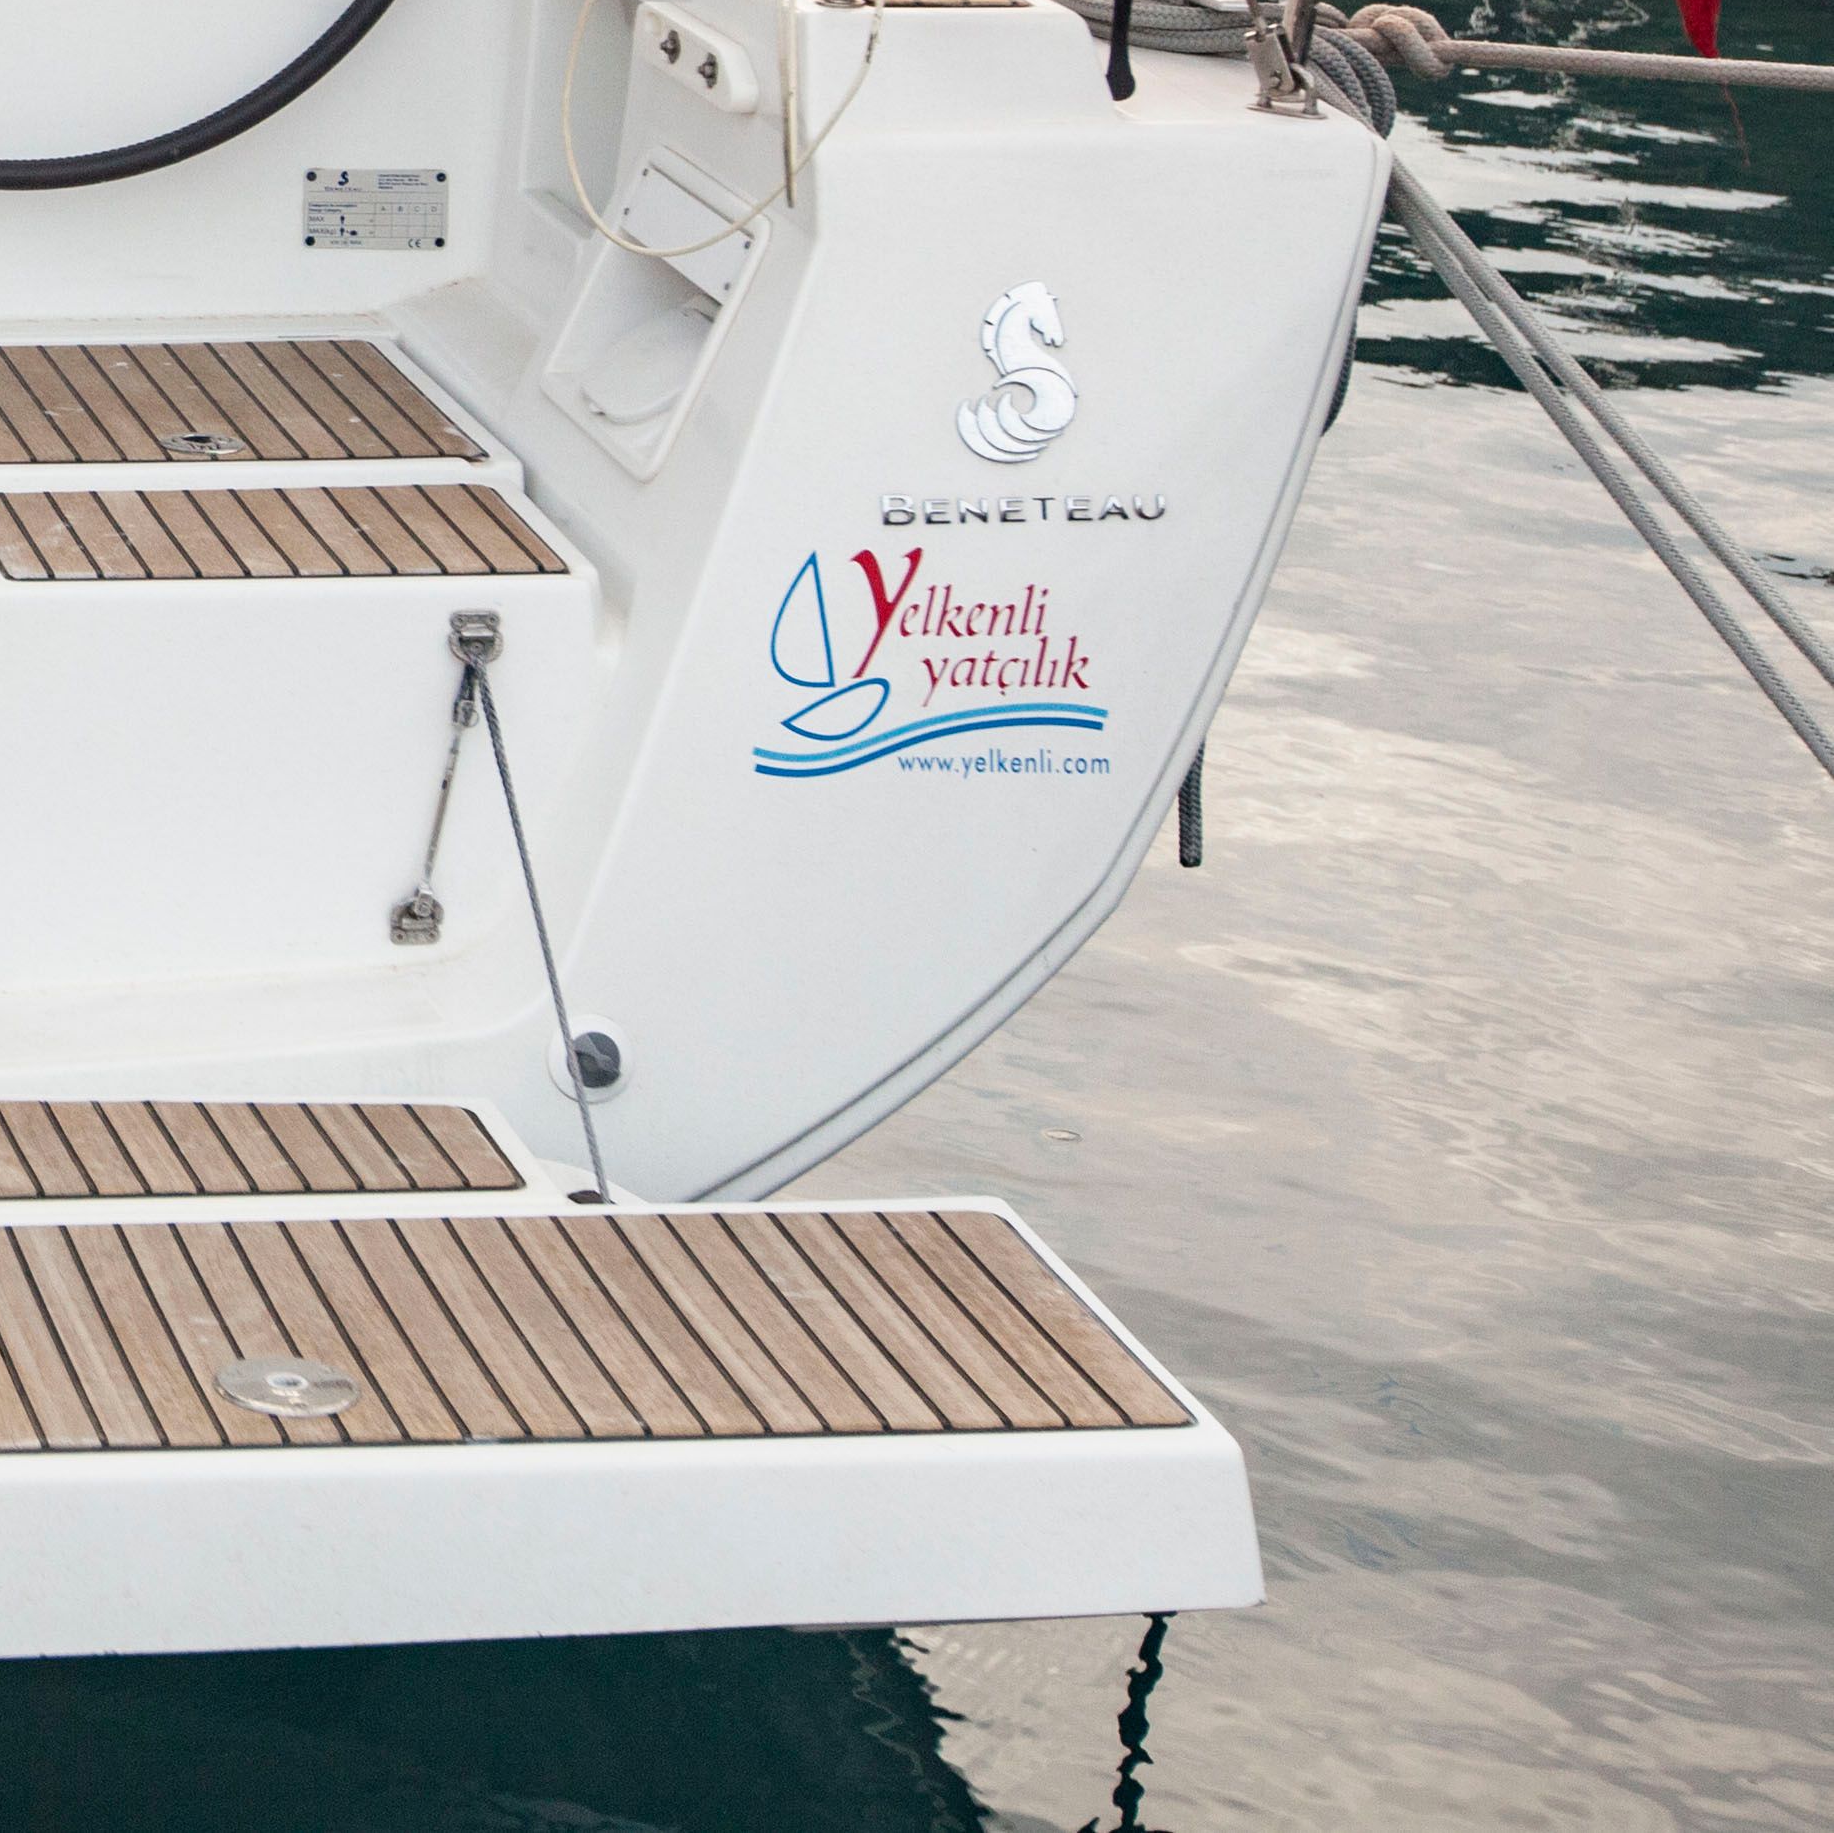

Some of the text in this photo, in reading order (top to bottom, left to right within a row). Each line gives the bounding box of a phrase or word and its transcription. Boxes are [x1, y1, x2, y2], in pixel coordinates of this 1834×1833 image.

[880, 494, 1166, 526] BENETEAU
[850, 547, 1049, 679] Yelkenli
[897, 749, 1111, 779] www.yelkenli.com
